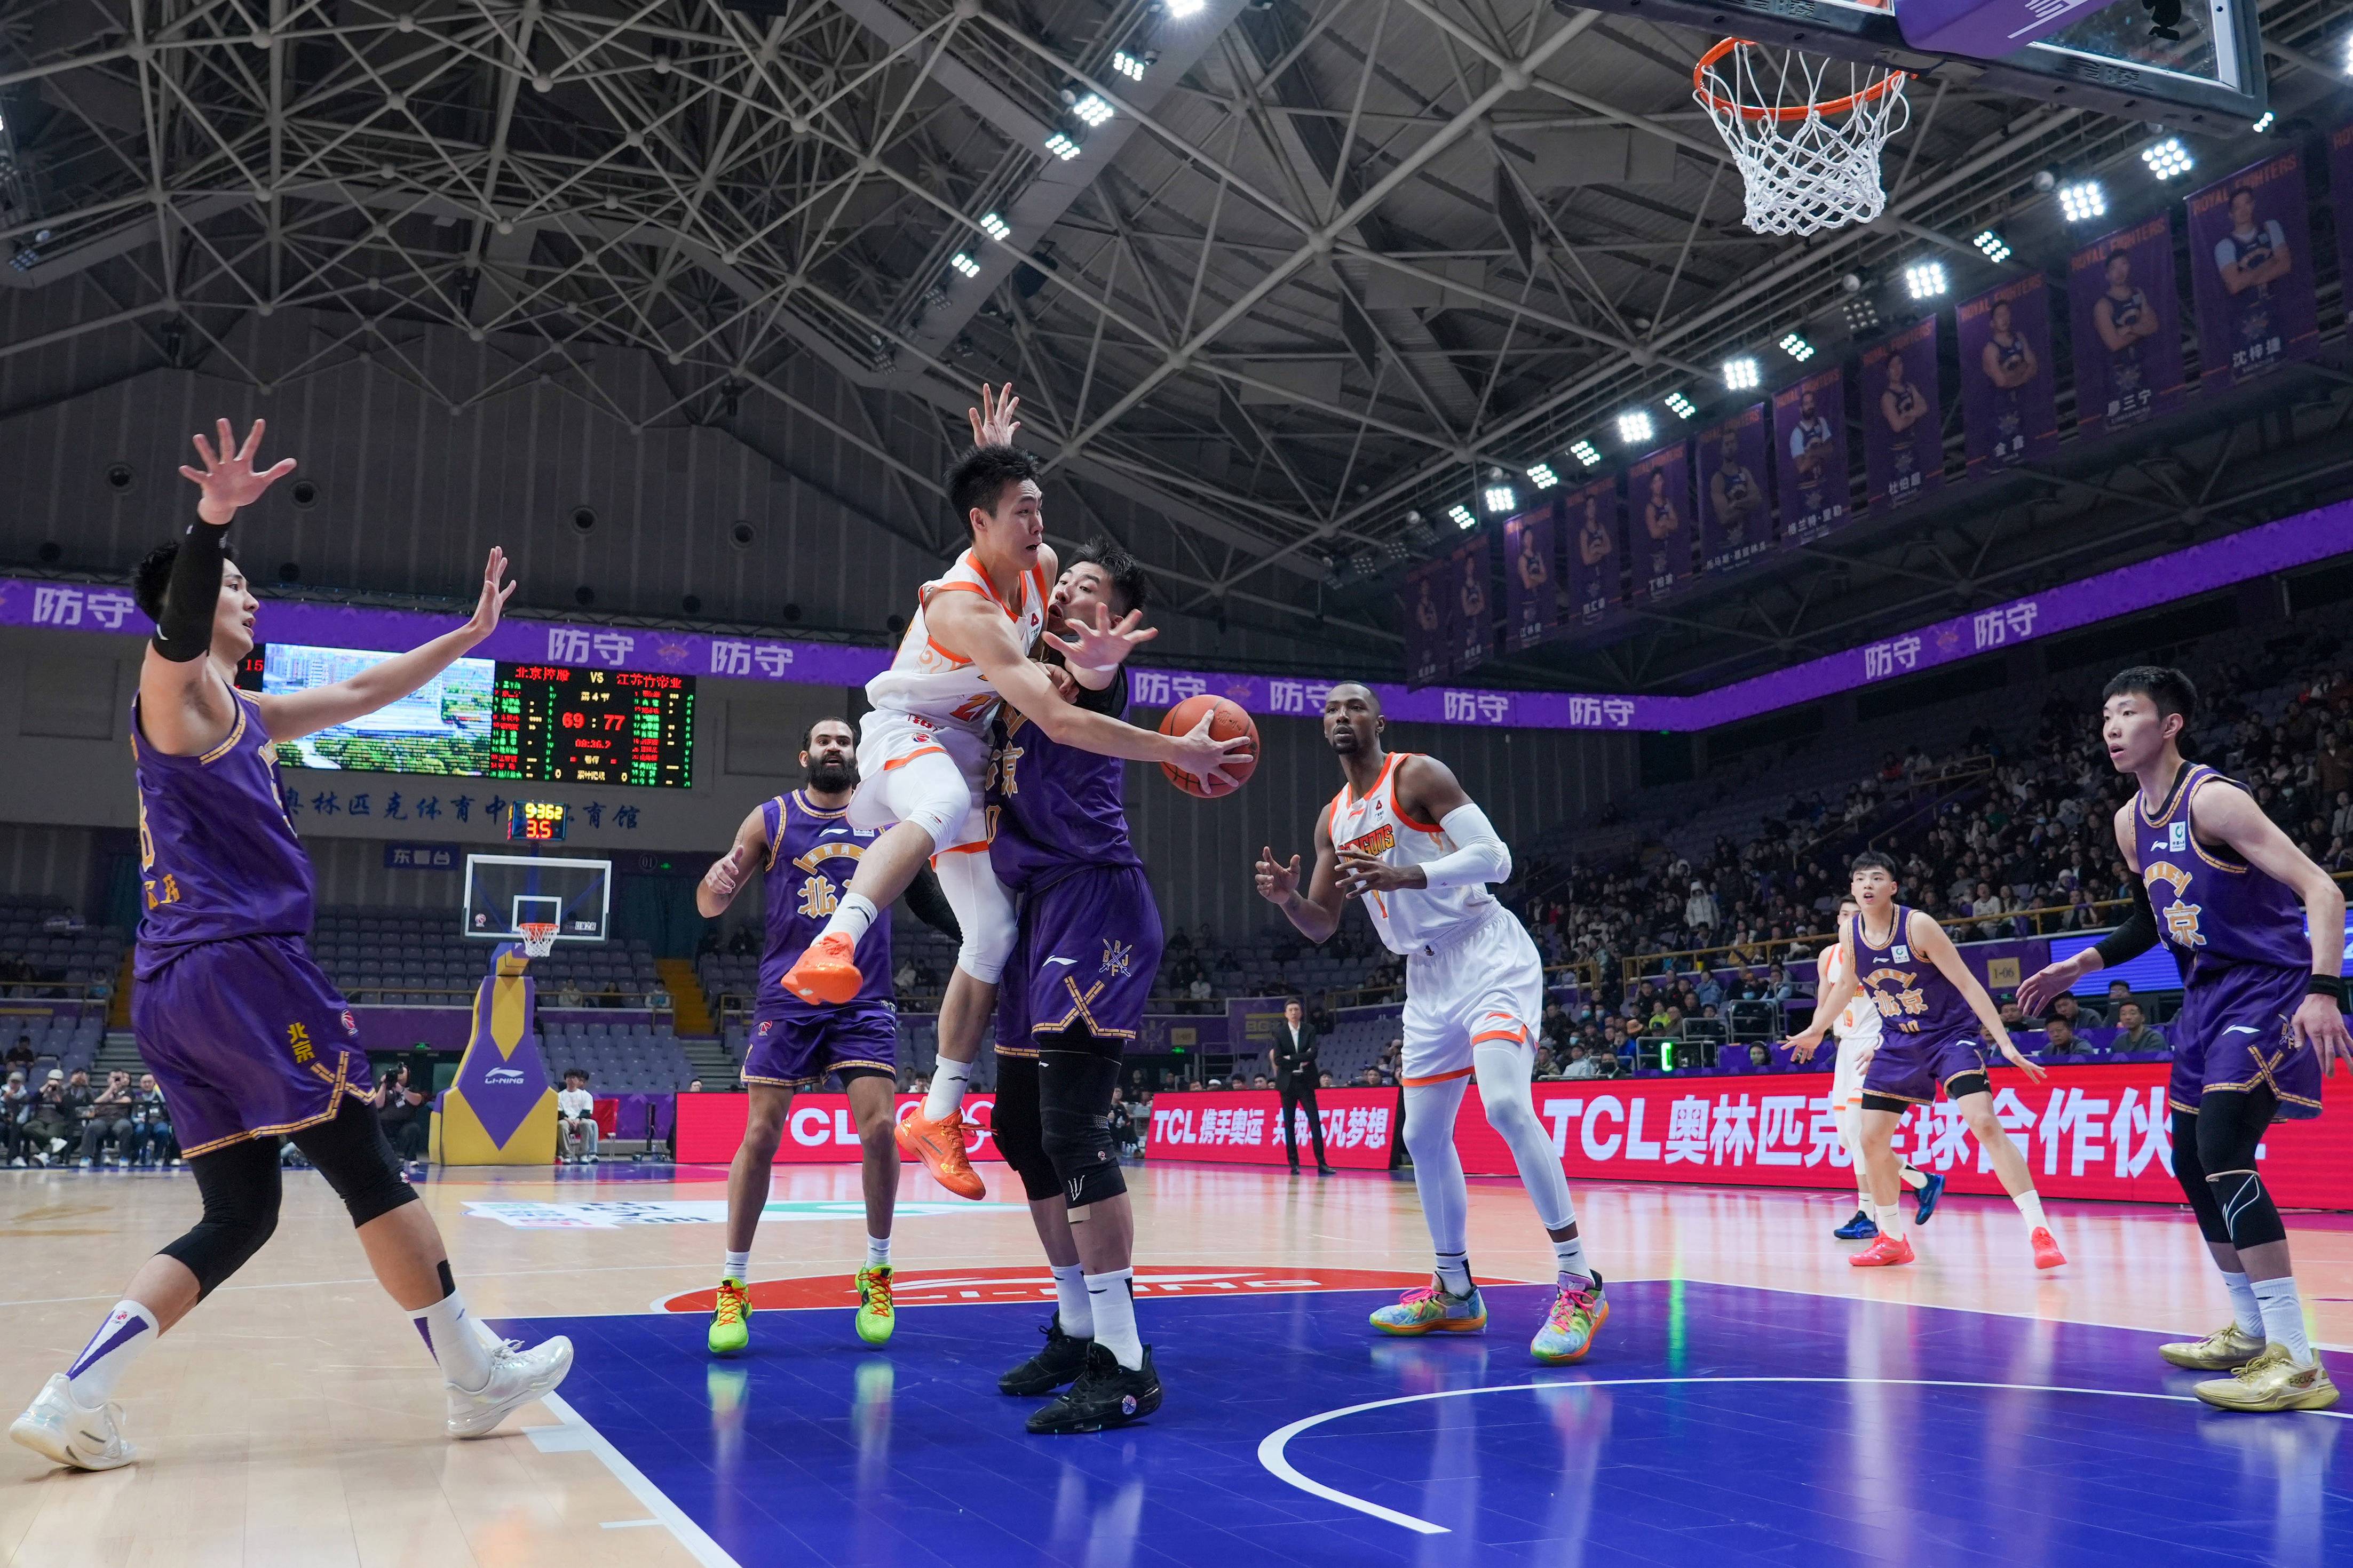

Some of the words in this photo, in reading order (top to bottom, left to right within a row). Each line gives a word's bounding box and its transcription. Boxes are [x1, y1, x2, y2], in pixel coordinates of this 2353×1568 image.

[2108, 389, 2151, 416] 三宁
[32, 587, 135, 628] 防守
[1974, 601, 2037, 649] 防守
[548, 628, 634, 666] 防守
[711, 640, 793, 676] 防守
[1865, 636, 1920, 679] 防守
[245, 659, 263, 671] 15
[590, 671, 604, 683] VS
[1135, 672, 1207, 704] 防守
[1270, 681, 1334, 713] 防守
[562, 712, 585, 729] 69
[604, 714, 626, 731] 77
[1444, 692, 1508, 723] 防守
[1568, 696, 1635, 727] 防守
[555, 769, 561, 779] 0
[621, 773, 628, 782] 0
[526, 819, 553, 839] 3.5
[1994, 968, 2015, 979] 1-06
[1872, 988, 1928, 1017] 北京
[287, 1022, 315, 1064] 北京
[787, 1107, 860, 1146] CL
[1154, 1109, 1196, 1143] TCL
[1199, 1108, 1265, 1145] 携手奥运
[1542, 1097, 1661, 1161] TCL
[1665, 1086, 2266, 1179] 奥林匹克球合作伙
[2288, 1373, 2315, 1387] FOCUS
